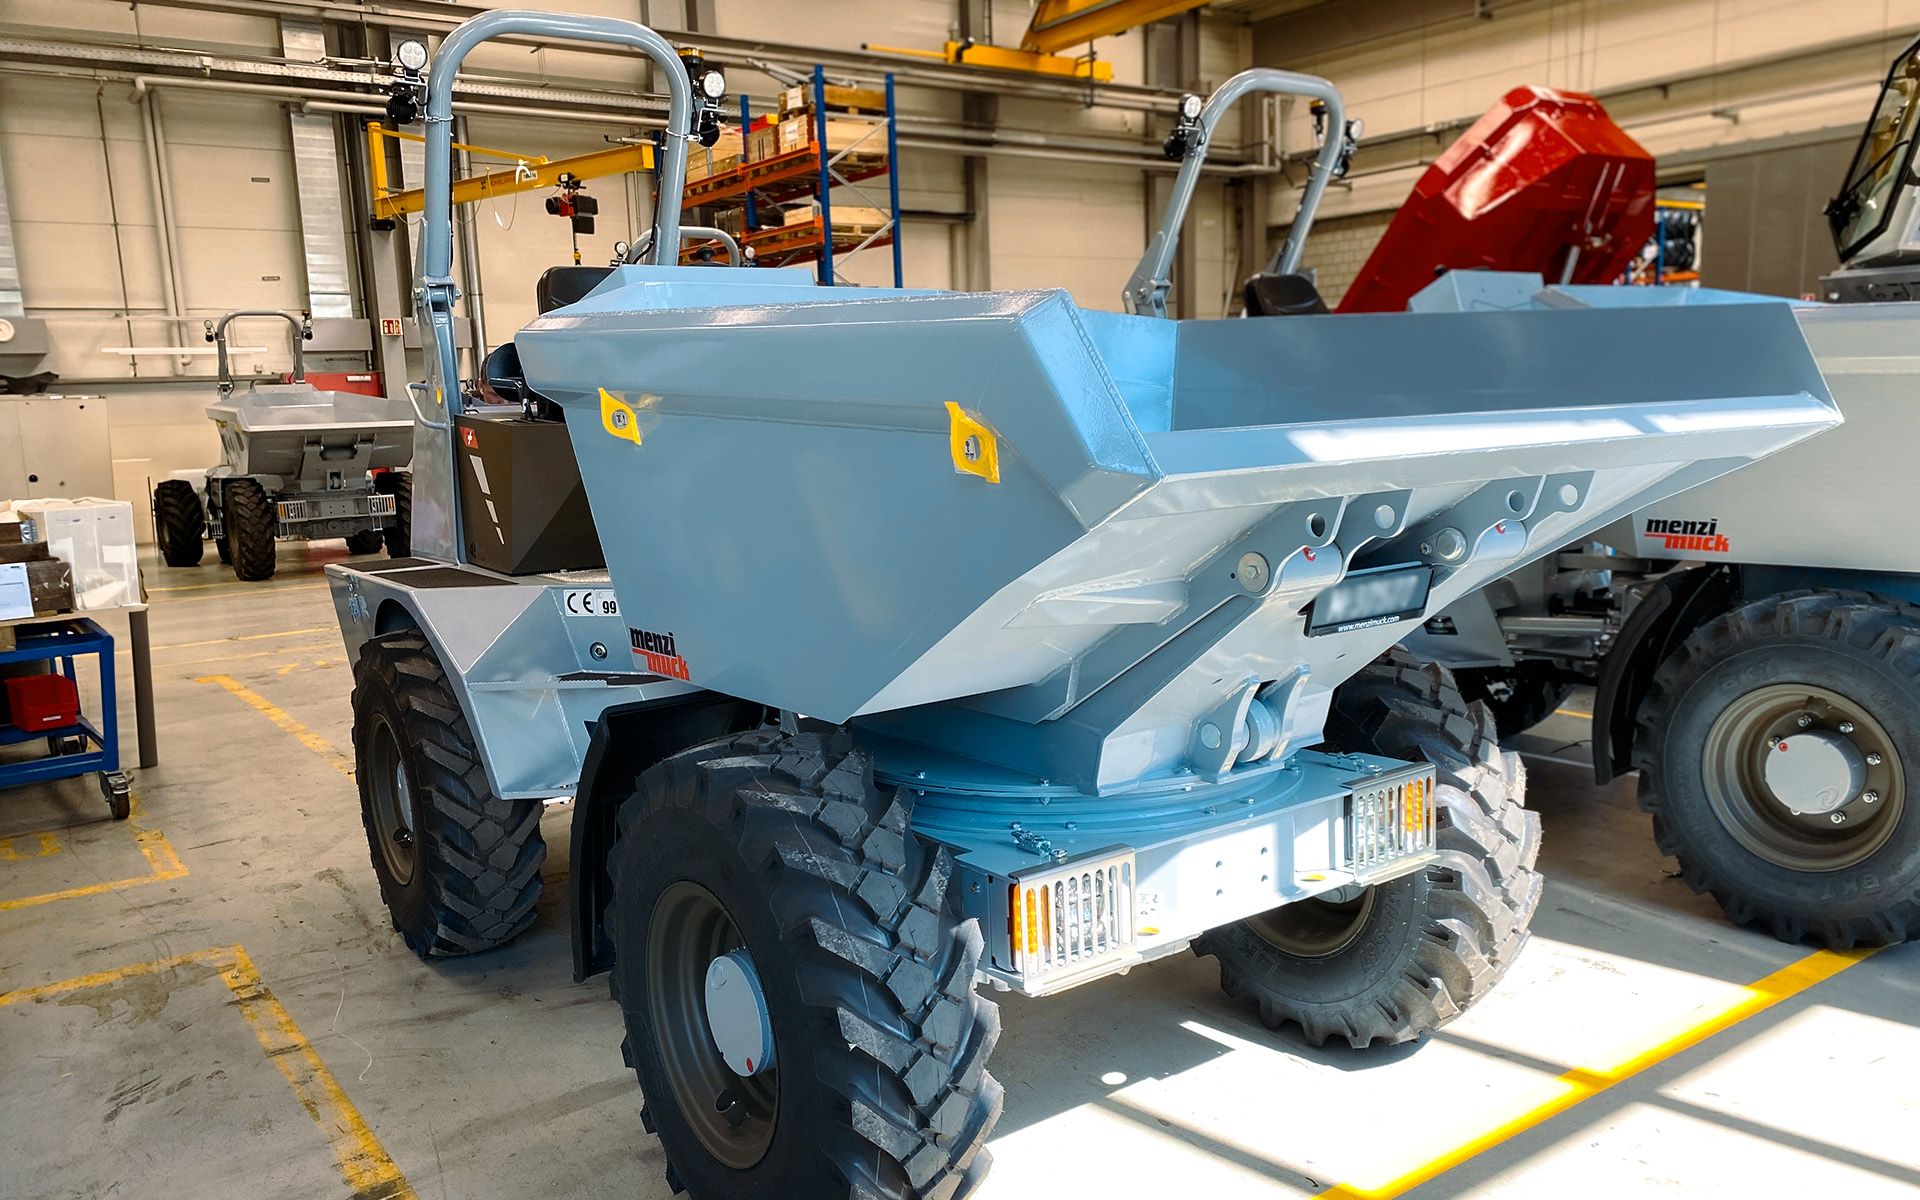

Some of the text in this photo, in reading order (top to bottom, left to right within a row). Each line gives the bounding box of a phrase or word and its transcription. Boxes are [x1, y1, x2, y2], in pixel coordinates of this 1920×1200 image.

[1645, 518, 1718, 537] menzi
[1664, 534, 1729, 552] muck
[567, 592, 594, 613] CE
[602, 600, 616, 614] 99
[1338, 615, 1400, 632] www.menzimuck.com
[629, 627, 677, 657] menzi
[646, 653, 690, 681] muck
